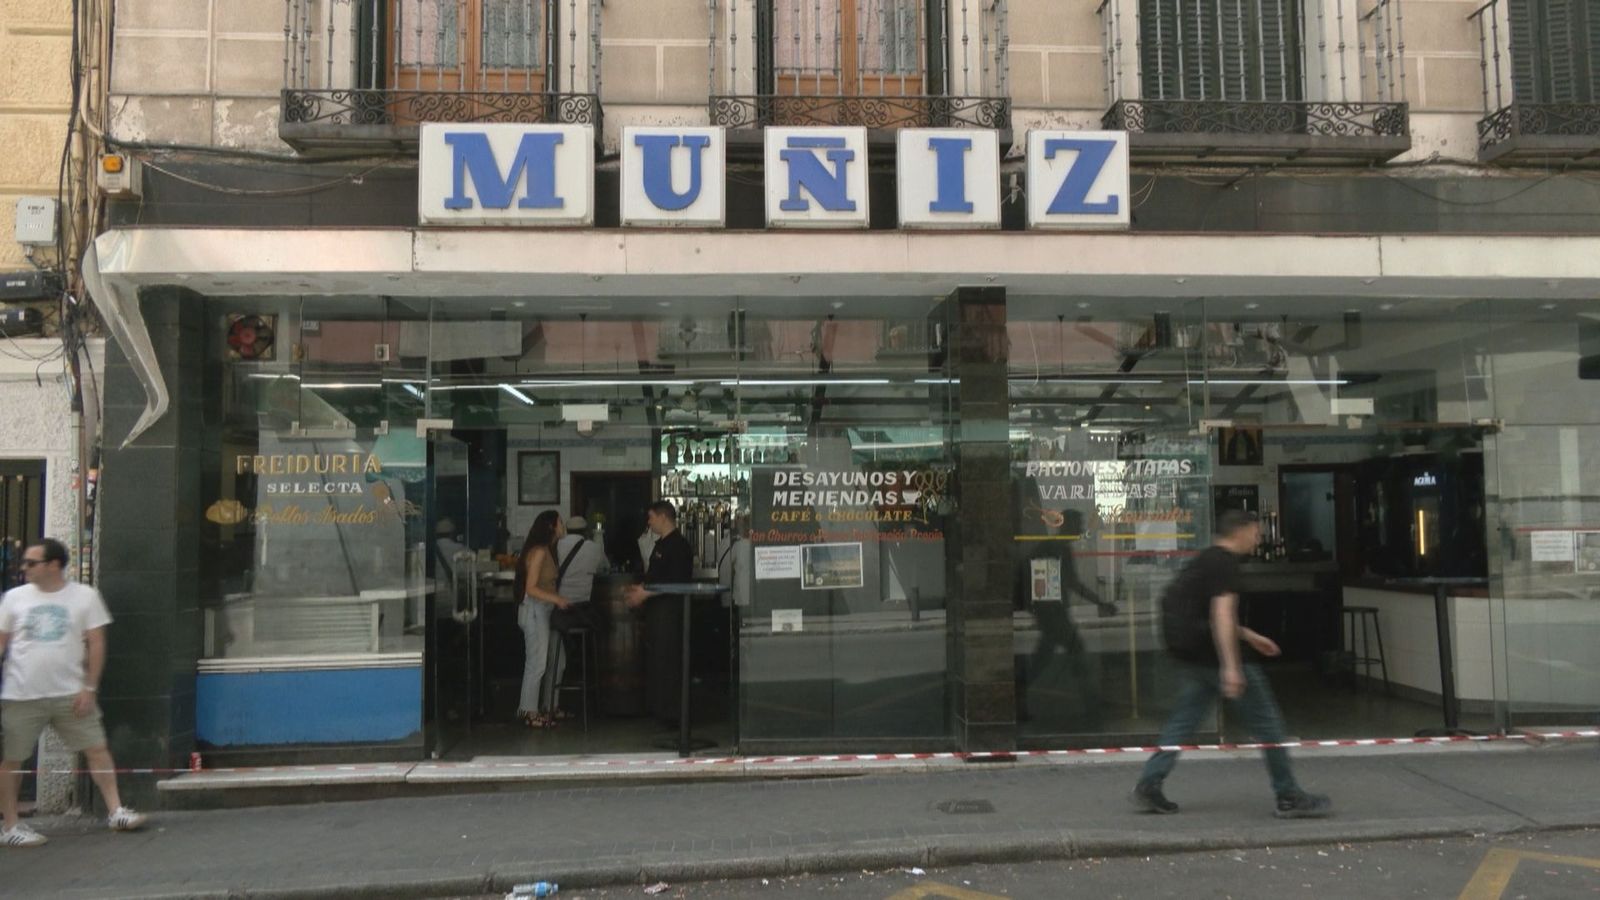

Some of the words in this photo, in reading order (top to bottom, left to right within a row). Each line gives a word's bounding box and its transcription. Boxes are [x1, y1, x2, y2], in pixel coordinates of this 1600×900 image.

[236, 454, 382, 475] FREIDURIA
[1025, 461, 1119, 477] RACIONES
[1133, 459, 1191, 476] TAPAS
[773, 471, 897, 486] DESAYUNOS
[903, 471, 917, 485] Y
[267, 482, 363, 493] SELECTA
[772, 491, 898, 506] MERIENDAS
[828, 510, 913, 521] CHOCOLATE
